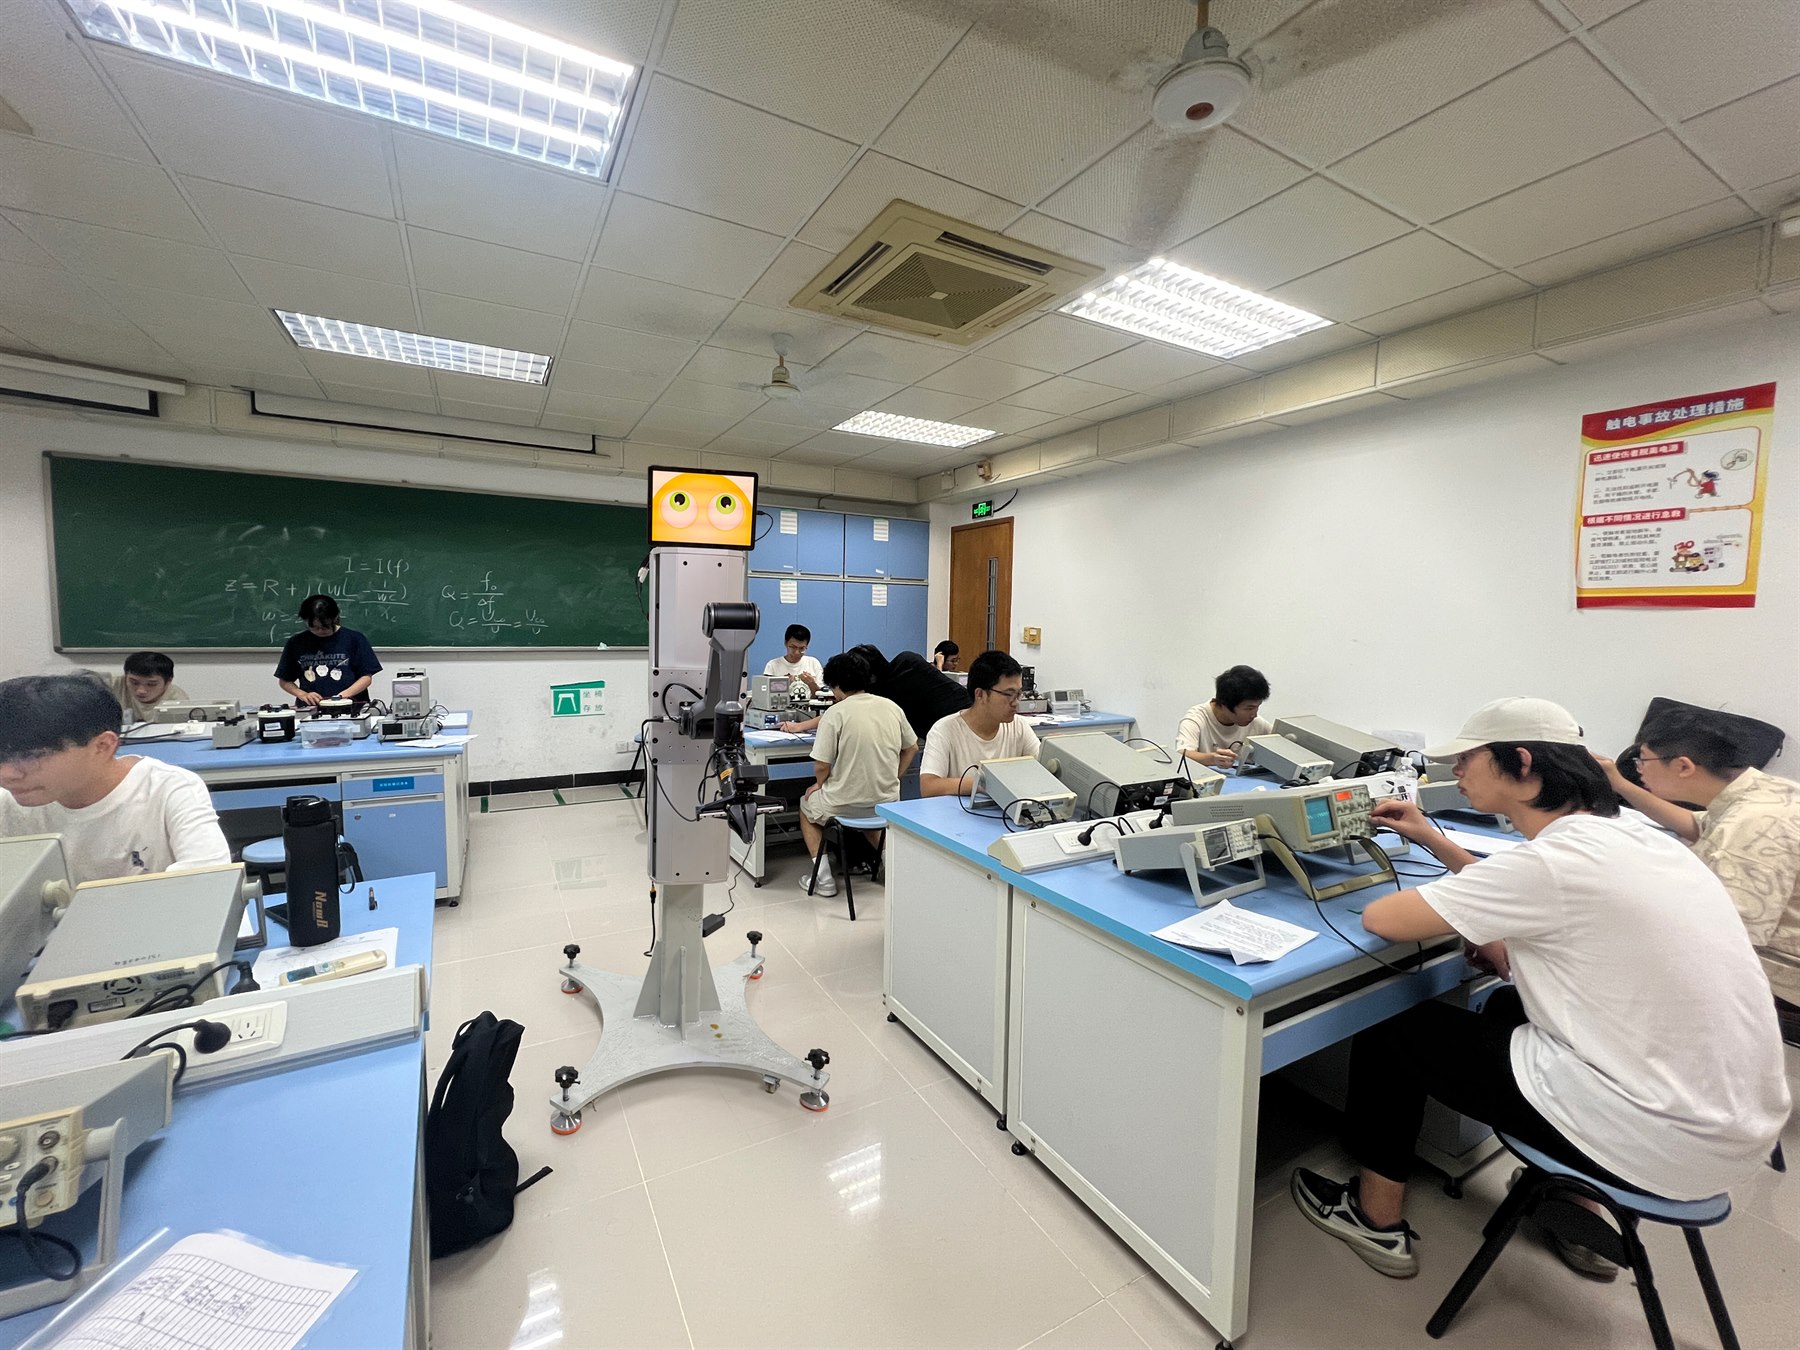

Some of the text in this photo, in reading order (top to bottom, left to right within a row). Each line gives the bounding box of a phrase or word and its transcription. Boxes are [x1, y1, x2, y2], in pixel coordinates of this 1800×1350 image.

[1606, 398, 1744, 431] 触电事故处理措施
[1593, 444, 1679, 462] 迅速使伤者脱离电源
[1587, 510, 1681, 524] 根据不同情况进行急救
